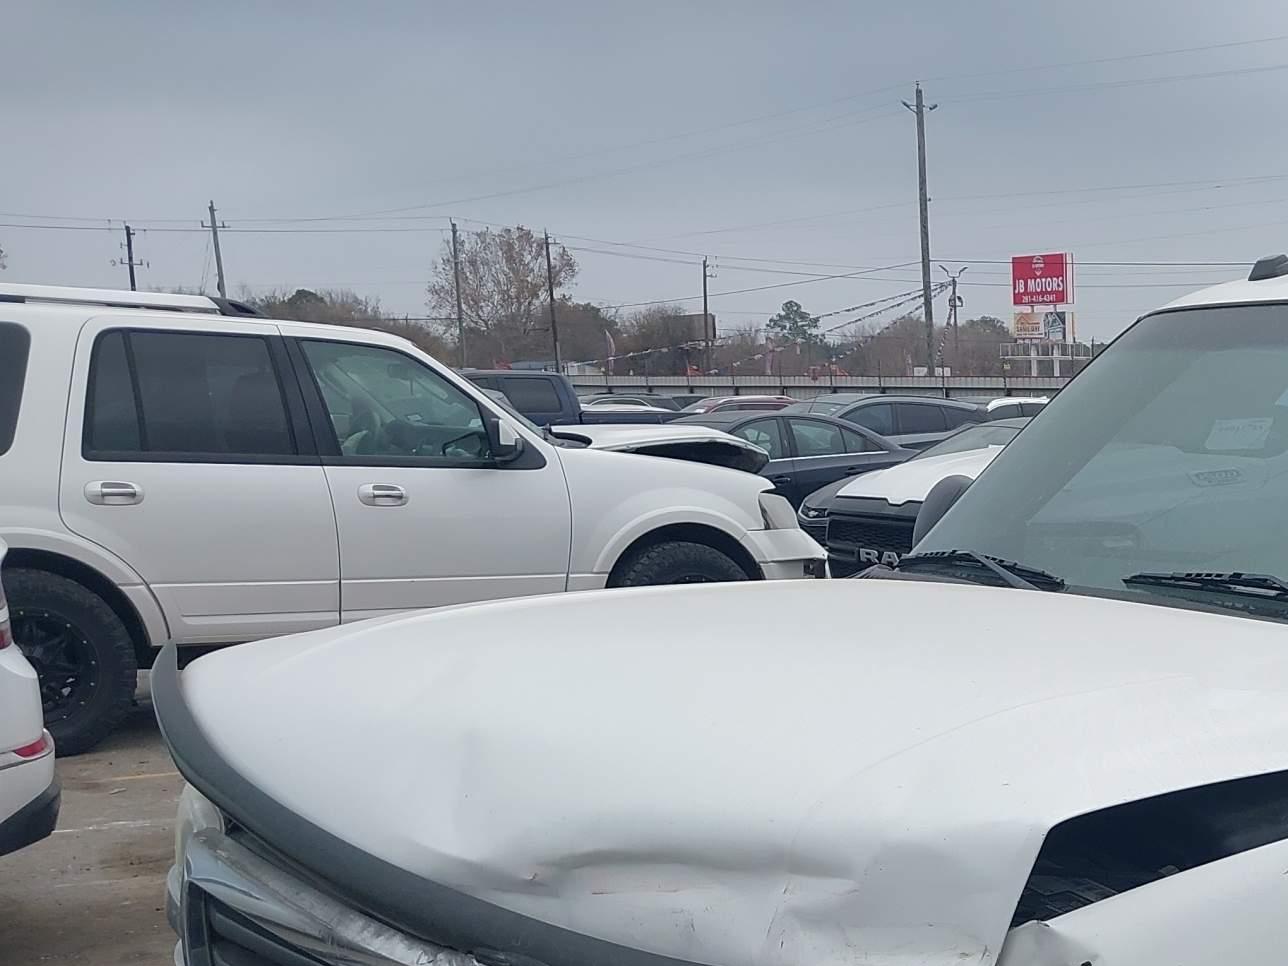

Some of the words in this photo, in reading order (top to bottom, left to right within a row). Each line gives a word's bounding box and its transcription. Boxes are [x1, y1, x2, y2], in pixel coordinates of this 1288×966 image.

[1015, 279, 1025, 294] JB
[1027, 276, 1064, 293] MOTORS
[859, 548, 901, 567] RA
